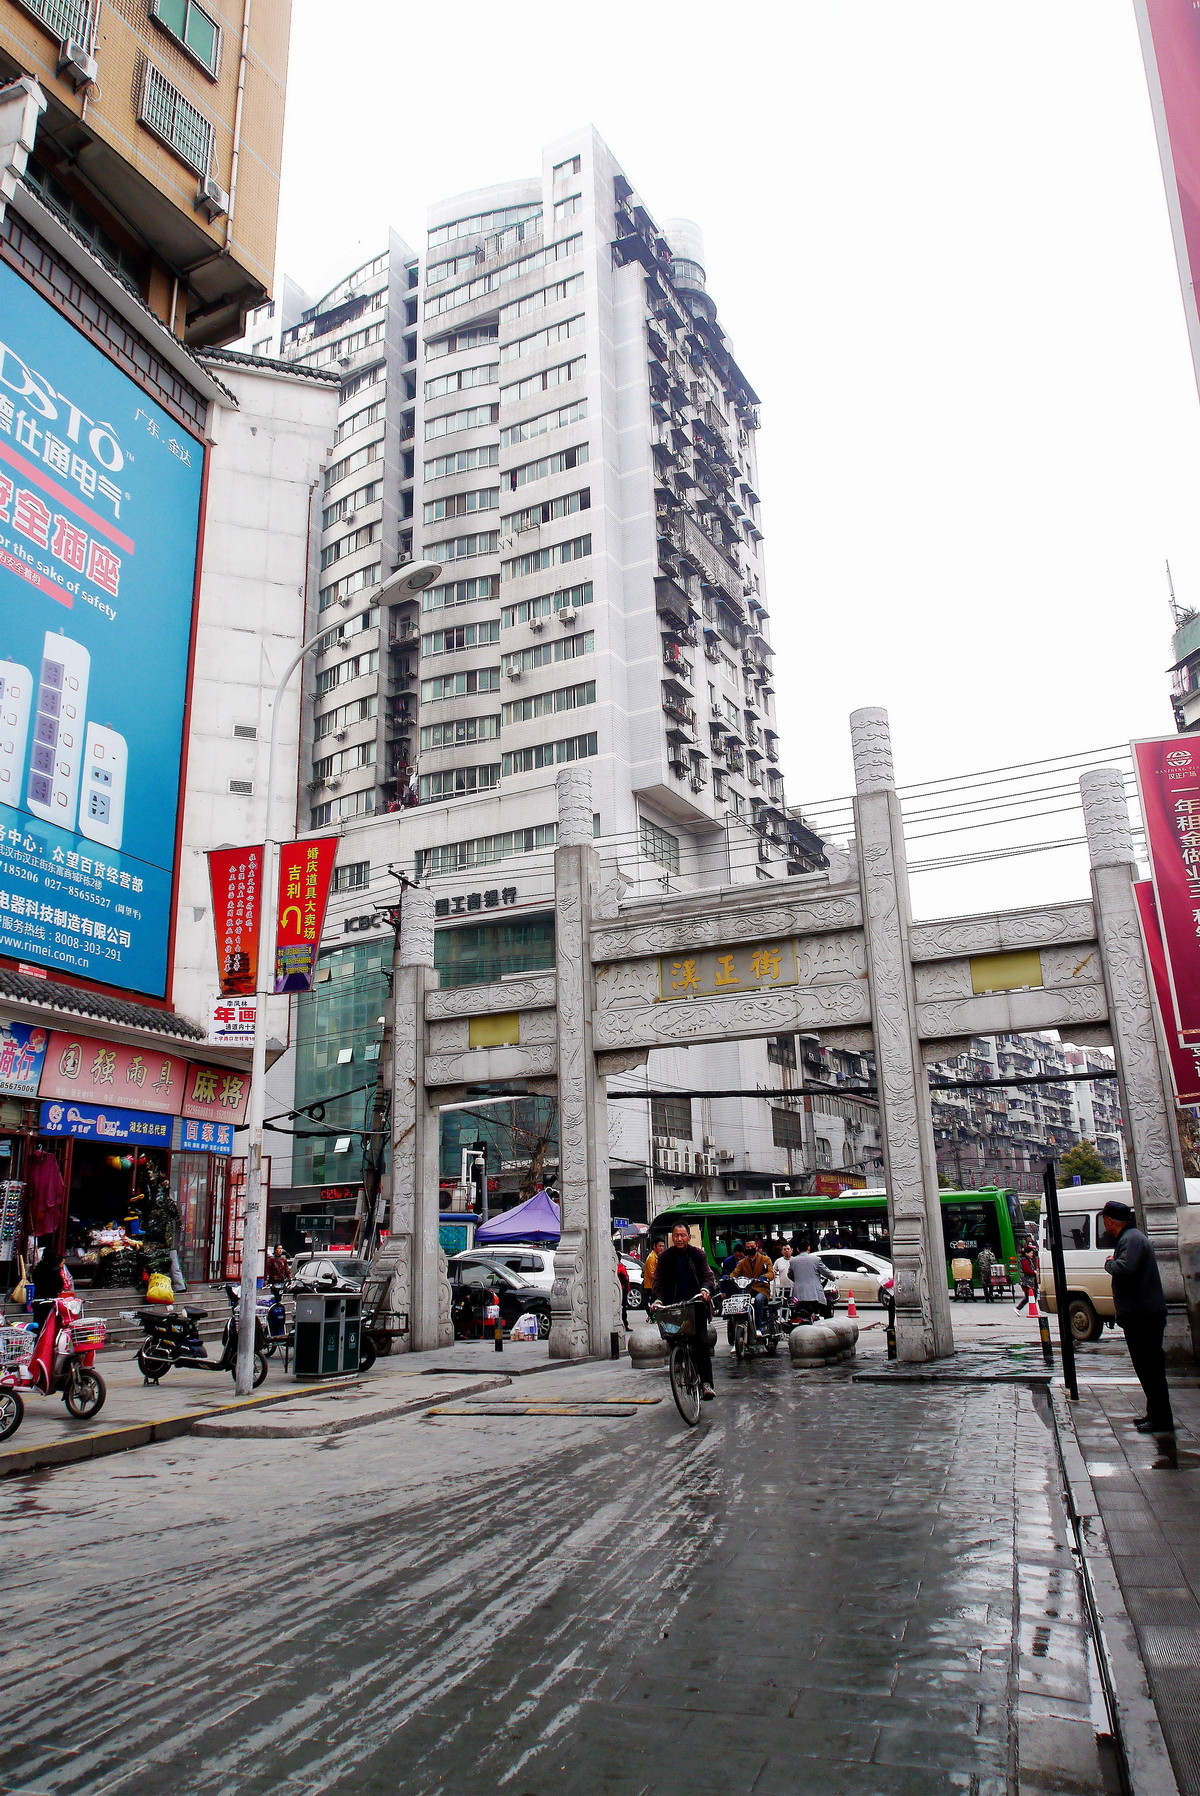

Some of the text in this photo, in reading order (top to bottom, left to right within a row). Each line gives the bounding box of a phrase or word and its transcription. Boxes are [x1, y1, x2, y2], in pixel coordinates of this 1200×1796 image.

[13, 543, 34, 565] the
[37, 560, 64, 585] sake
[67, 581, 80, 595] of
[81, 590, 118, 621] safety
[287, 864, 302, 899] 吉利
[303, 847, 319, 940] 婚庆道具大卖场
[0, 889, 131, 949] 电器科技制造有限公司
[343, 914, 381, 934] ICBC
[213, 1006, 256, 1023] 年画
[0, 1039, 36, 1081] 商行
[59, 1042, 174, 1096] 国强雨具
[191, 1070, 244, 1109] 麻将
[129, 1120, 168, 1137] 湖北省总代理
[186, 1120, 230, 1144] 百家乐
